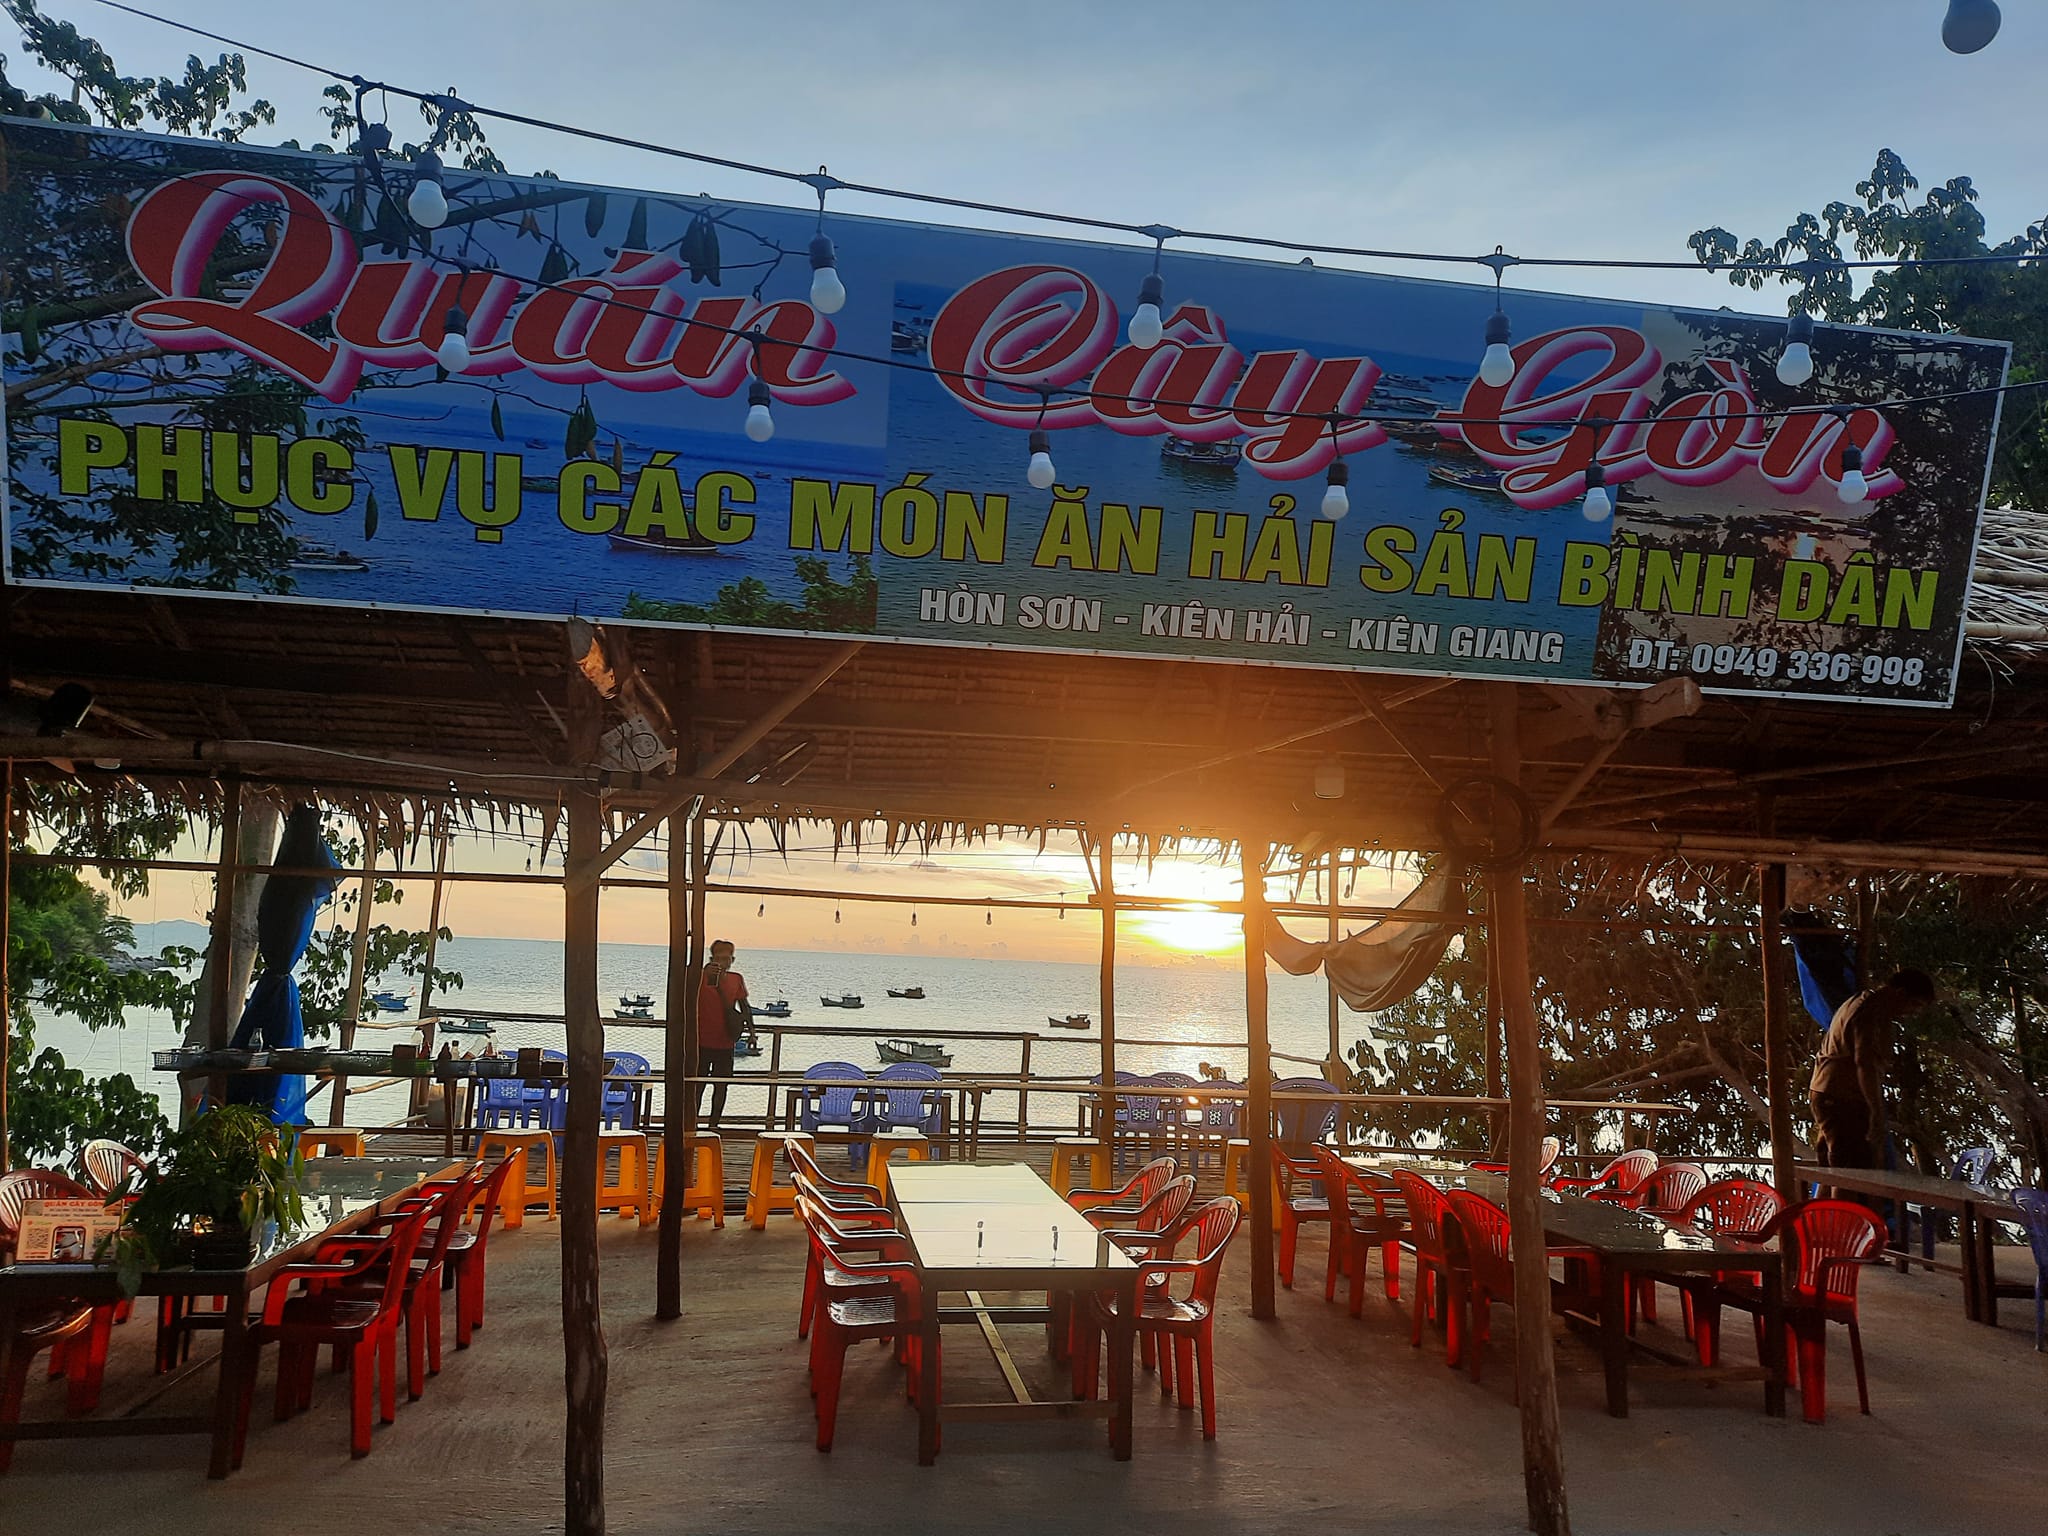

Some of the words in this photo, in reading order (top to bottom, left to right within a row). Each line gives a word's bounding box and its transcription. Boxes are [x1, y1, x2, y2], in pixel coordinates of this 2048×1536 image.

[125, 169, 857, 402] Quán
[928, 264, 1388, 481] Cây
[1434, 325, 1905, 510] Gòn
[57, 419, 354, 524] PHỤC
[388, 445, 522, 542] VỤ
[559, 451, 756, 545] CÁC
[789, 473, 1009, 566] MÓN
[1032, 485, 1163, 576] ĂN
[1188, 493, 1335, 587] HẢI
[1360, 509, 1538, 604] SẢN
[1559, 534, 1755, 619] BÌNH
[1776, 550, 1939, 631] DÂN
[919, 583, 1005, 626] HÒN
[1017, 594, 1102, 632] SƠN
[1141, 600, 1234, 641] KIÊN
[1245, 602, 1310, 647] HẢI
[1348, 615, 1439, 655] KIÊN
[1449, 625, 1565, 664] GIANG
[1628, 638, 1681, 671] ĐT:
[1691, 643, 1779, 678] 0949
[1787, 650, 1851, 682] 336
[1861, 655, 1925, 687] 998
